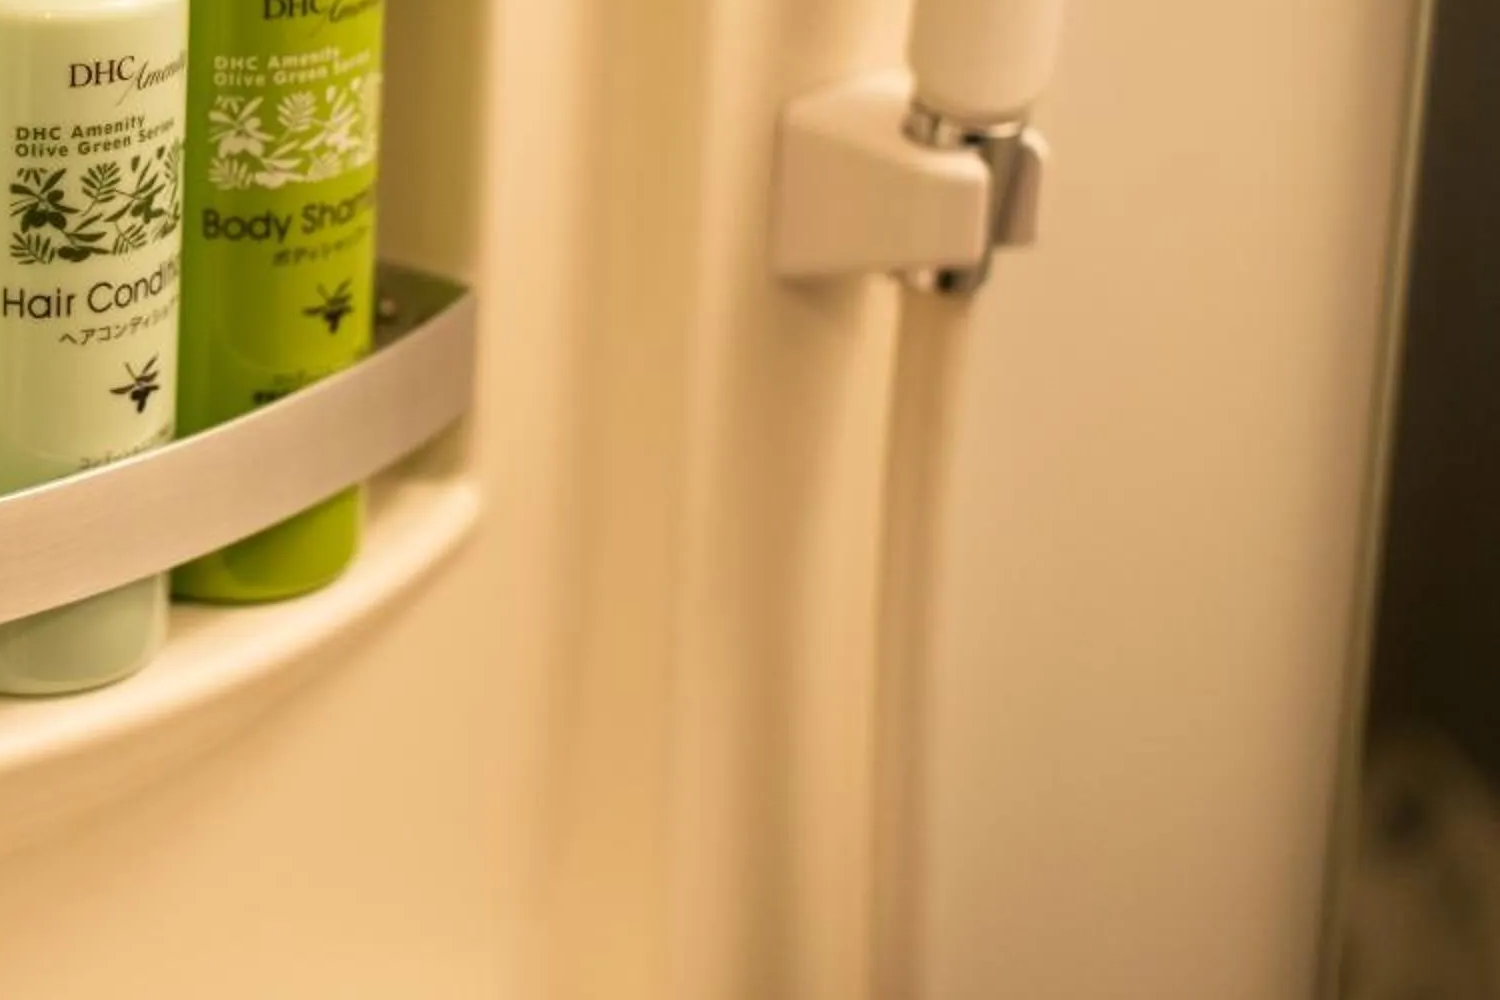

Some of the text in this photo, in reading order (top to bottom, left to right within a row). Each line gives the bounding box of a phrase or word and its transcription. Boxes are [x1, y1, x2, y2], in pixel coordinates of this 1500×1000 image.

[68, 55, 135, 88] DHC
[214, 56, 259, 71] DHC
[214, 73, 266, 87] Olive
[273, 67, 329, 85] Green
[15, 117, 175, 158] Olive Green Series
[16, 115, 146, 141] DHC Amenity
[202, 208, 292, 244] Body
[3, 288, 77, 319] Hair
